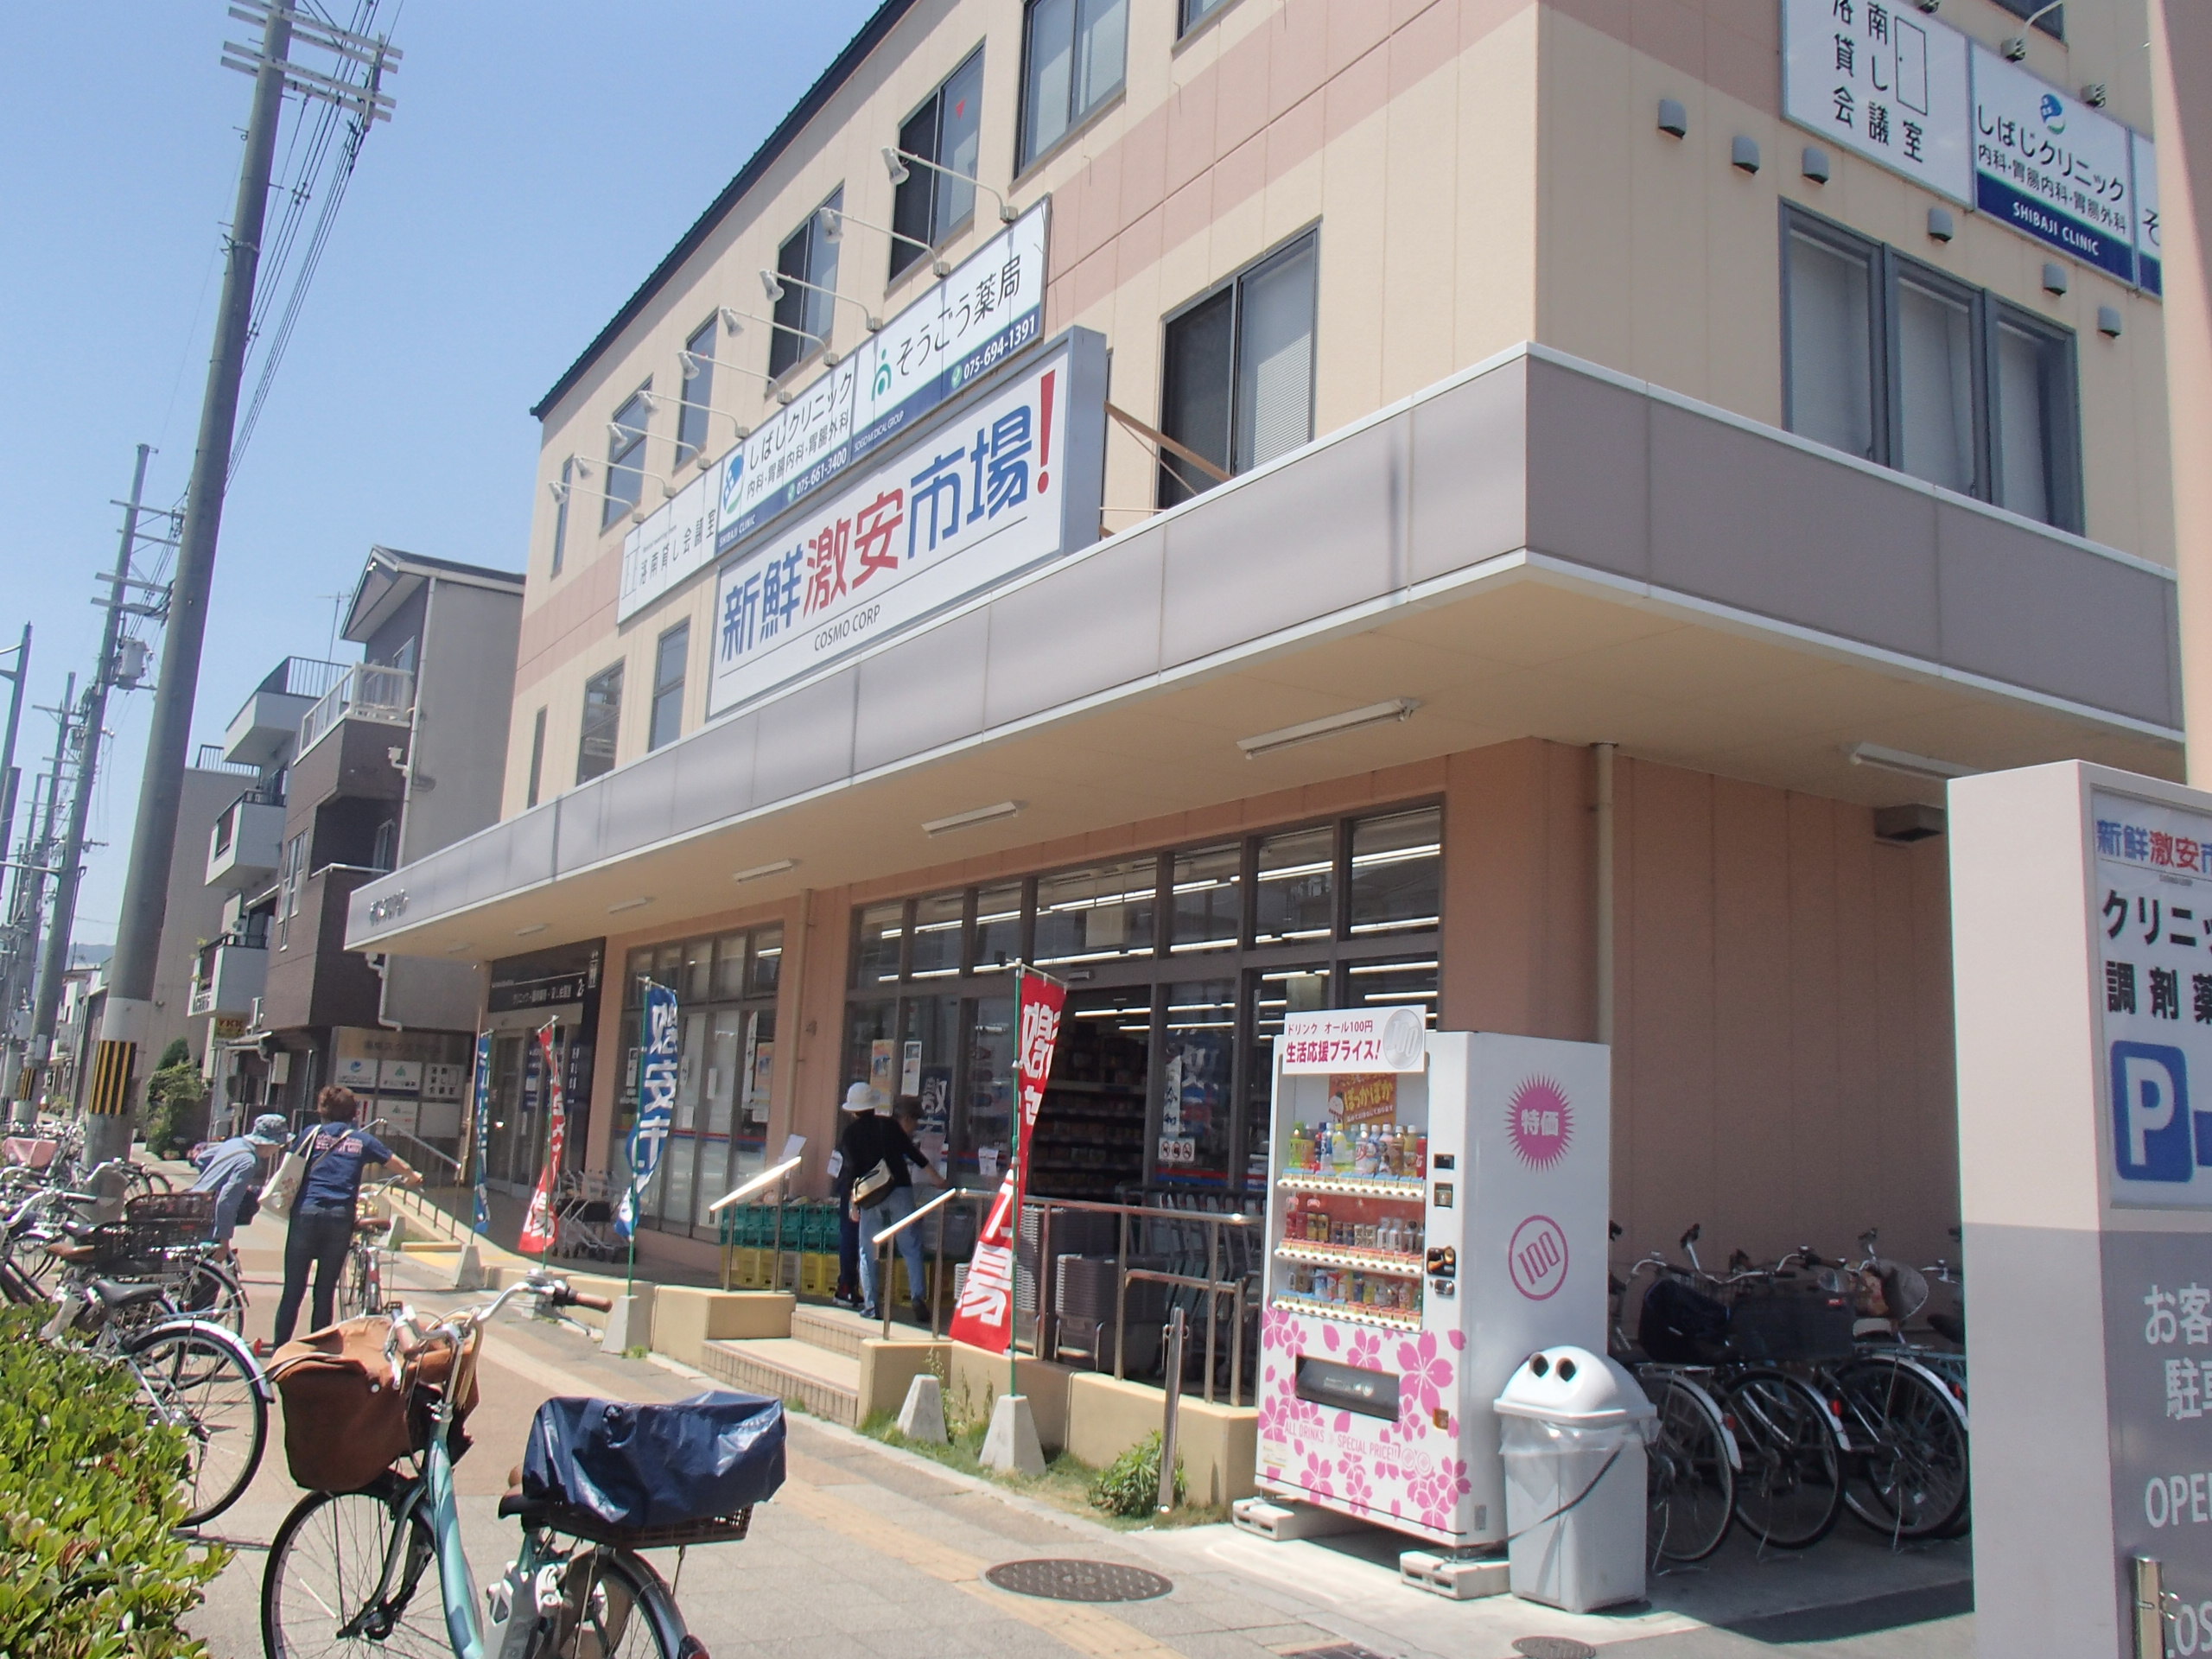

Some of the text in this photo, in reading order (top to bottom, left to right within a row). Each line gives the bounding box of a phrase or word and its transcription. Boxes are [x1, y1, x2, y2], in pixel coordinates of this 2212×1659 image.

[1834, 33, 1888, 91] 貸し
[1834, 86, 1923, 162] 会議室
[1978, 105, 2124, 201] しばじクリニック
[2012, 201, 2100, 256] SHIBAJI CLINIC
[896, 254, 1021, 377] そうごう薬局
[963, 315, 1035, 379] 075-694-1391
[749, 372, 852, 470] しばじクリニック
[796, 448, 848, 495] 075-661-3400
[814, 604, 880, 652] COSMO CORP
[2102, 890, 2212, 954] クリニ
[1286, 1039, 1382, 1064] 生活応援プライス!
[1287, 1020, 1373, 1036] ドリンク オール100円
[1521, 1109, 1559, 1136] 特価
[2126, 1057, 2175, 1166] P
[1517, 1230, 1560, 1285] 100
[1285, 1420, 1297, 1435] ALL
[1299, 1425, 1325, 1443] DRINKS
[1337, 1434, 1366, 1454] SPECIAL
[2145, 1472, 2212, 1529] OPE
